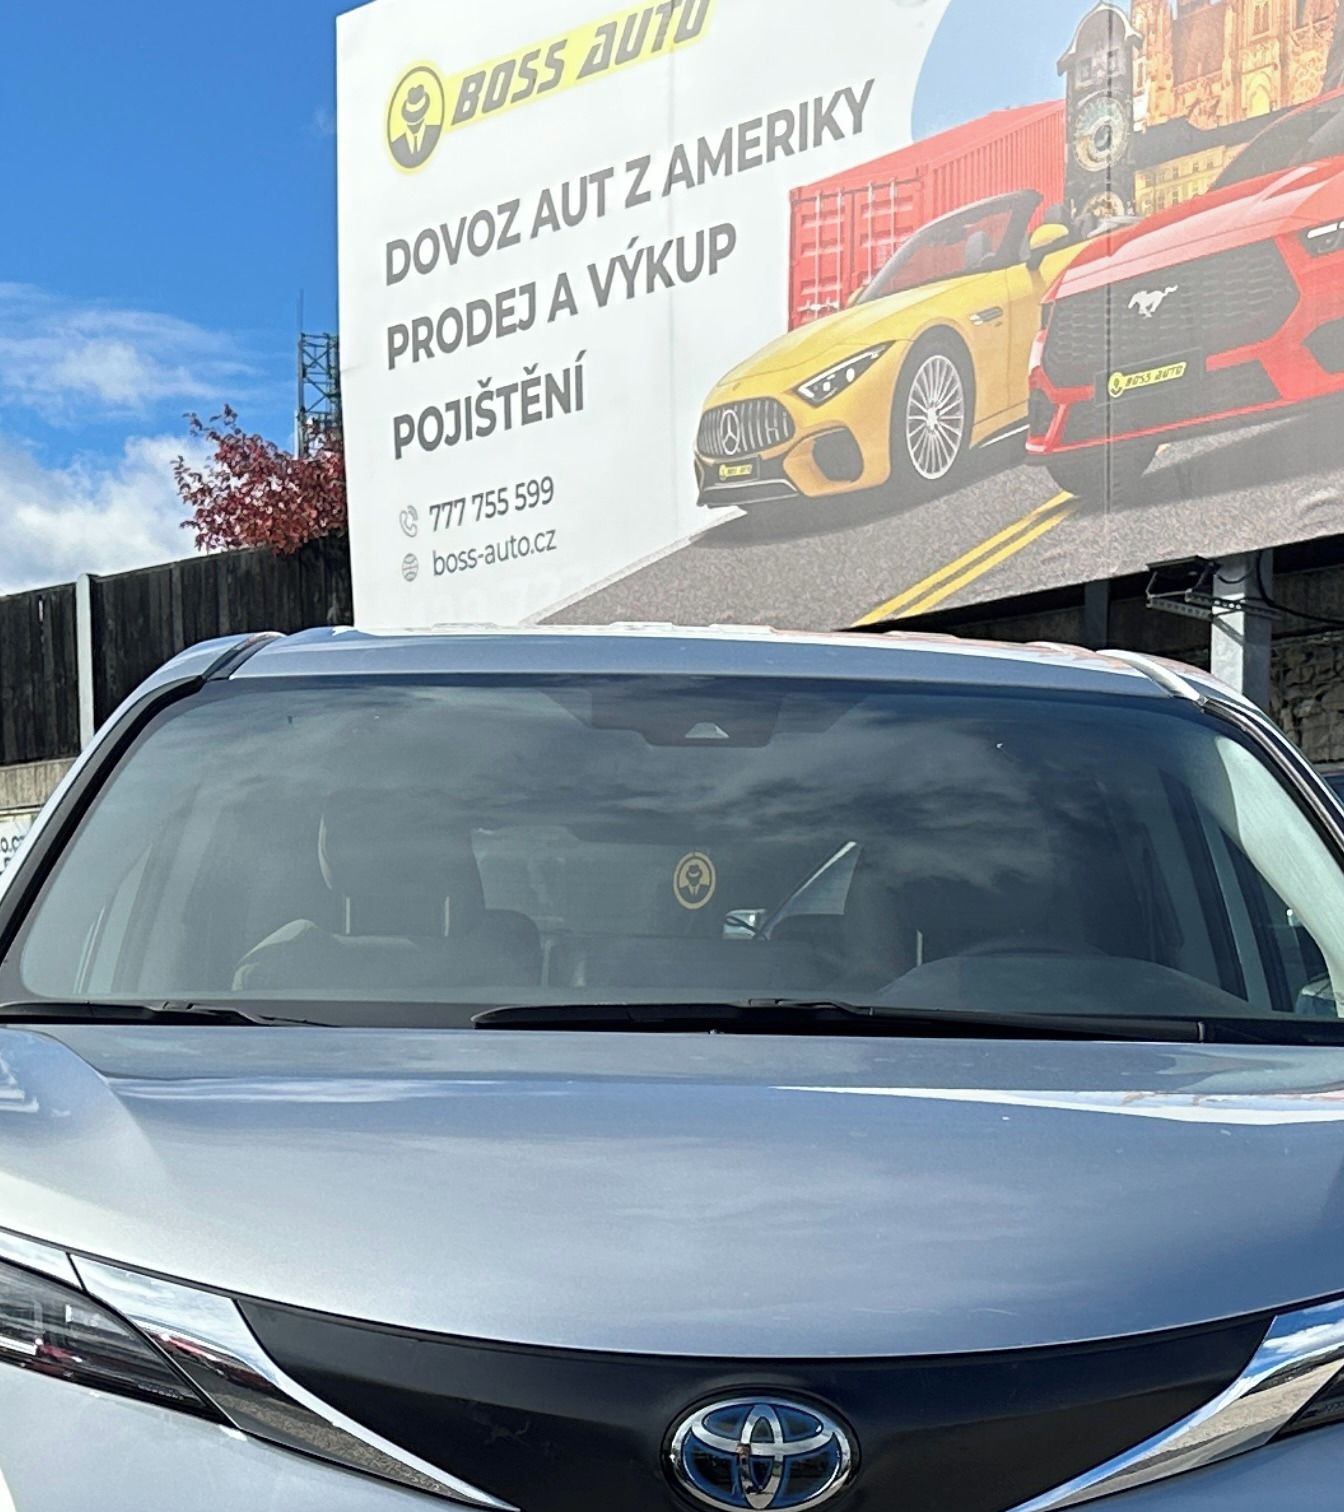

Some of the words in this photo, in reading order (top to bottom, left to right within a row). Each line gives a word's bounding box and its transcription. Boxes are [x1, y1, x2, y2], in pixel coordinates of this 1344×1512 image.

[450, 38, 568, 126] BOSS
[576, 0, 708, 80] AUTO
[385, 198, 521, 286] DOVOZ
[530, 167, 615, 240] AUT
[625, 154, 652, 210] Z
[662, 77, 876, 199] AMERIKY
[387, 290, 537, 371] PRODEJ
[547, 272, 579, 323] A
[587, 221, 737, 308] VÝKUP
[392, 350, 588, 460] POJIŠTĚNÍ
[429, 497, 467, 532] 777
[471, 487, 509, 522] 755
[514, 475, 555, 511] 599
[432, 528, 558, 576] boss-auto.cz
